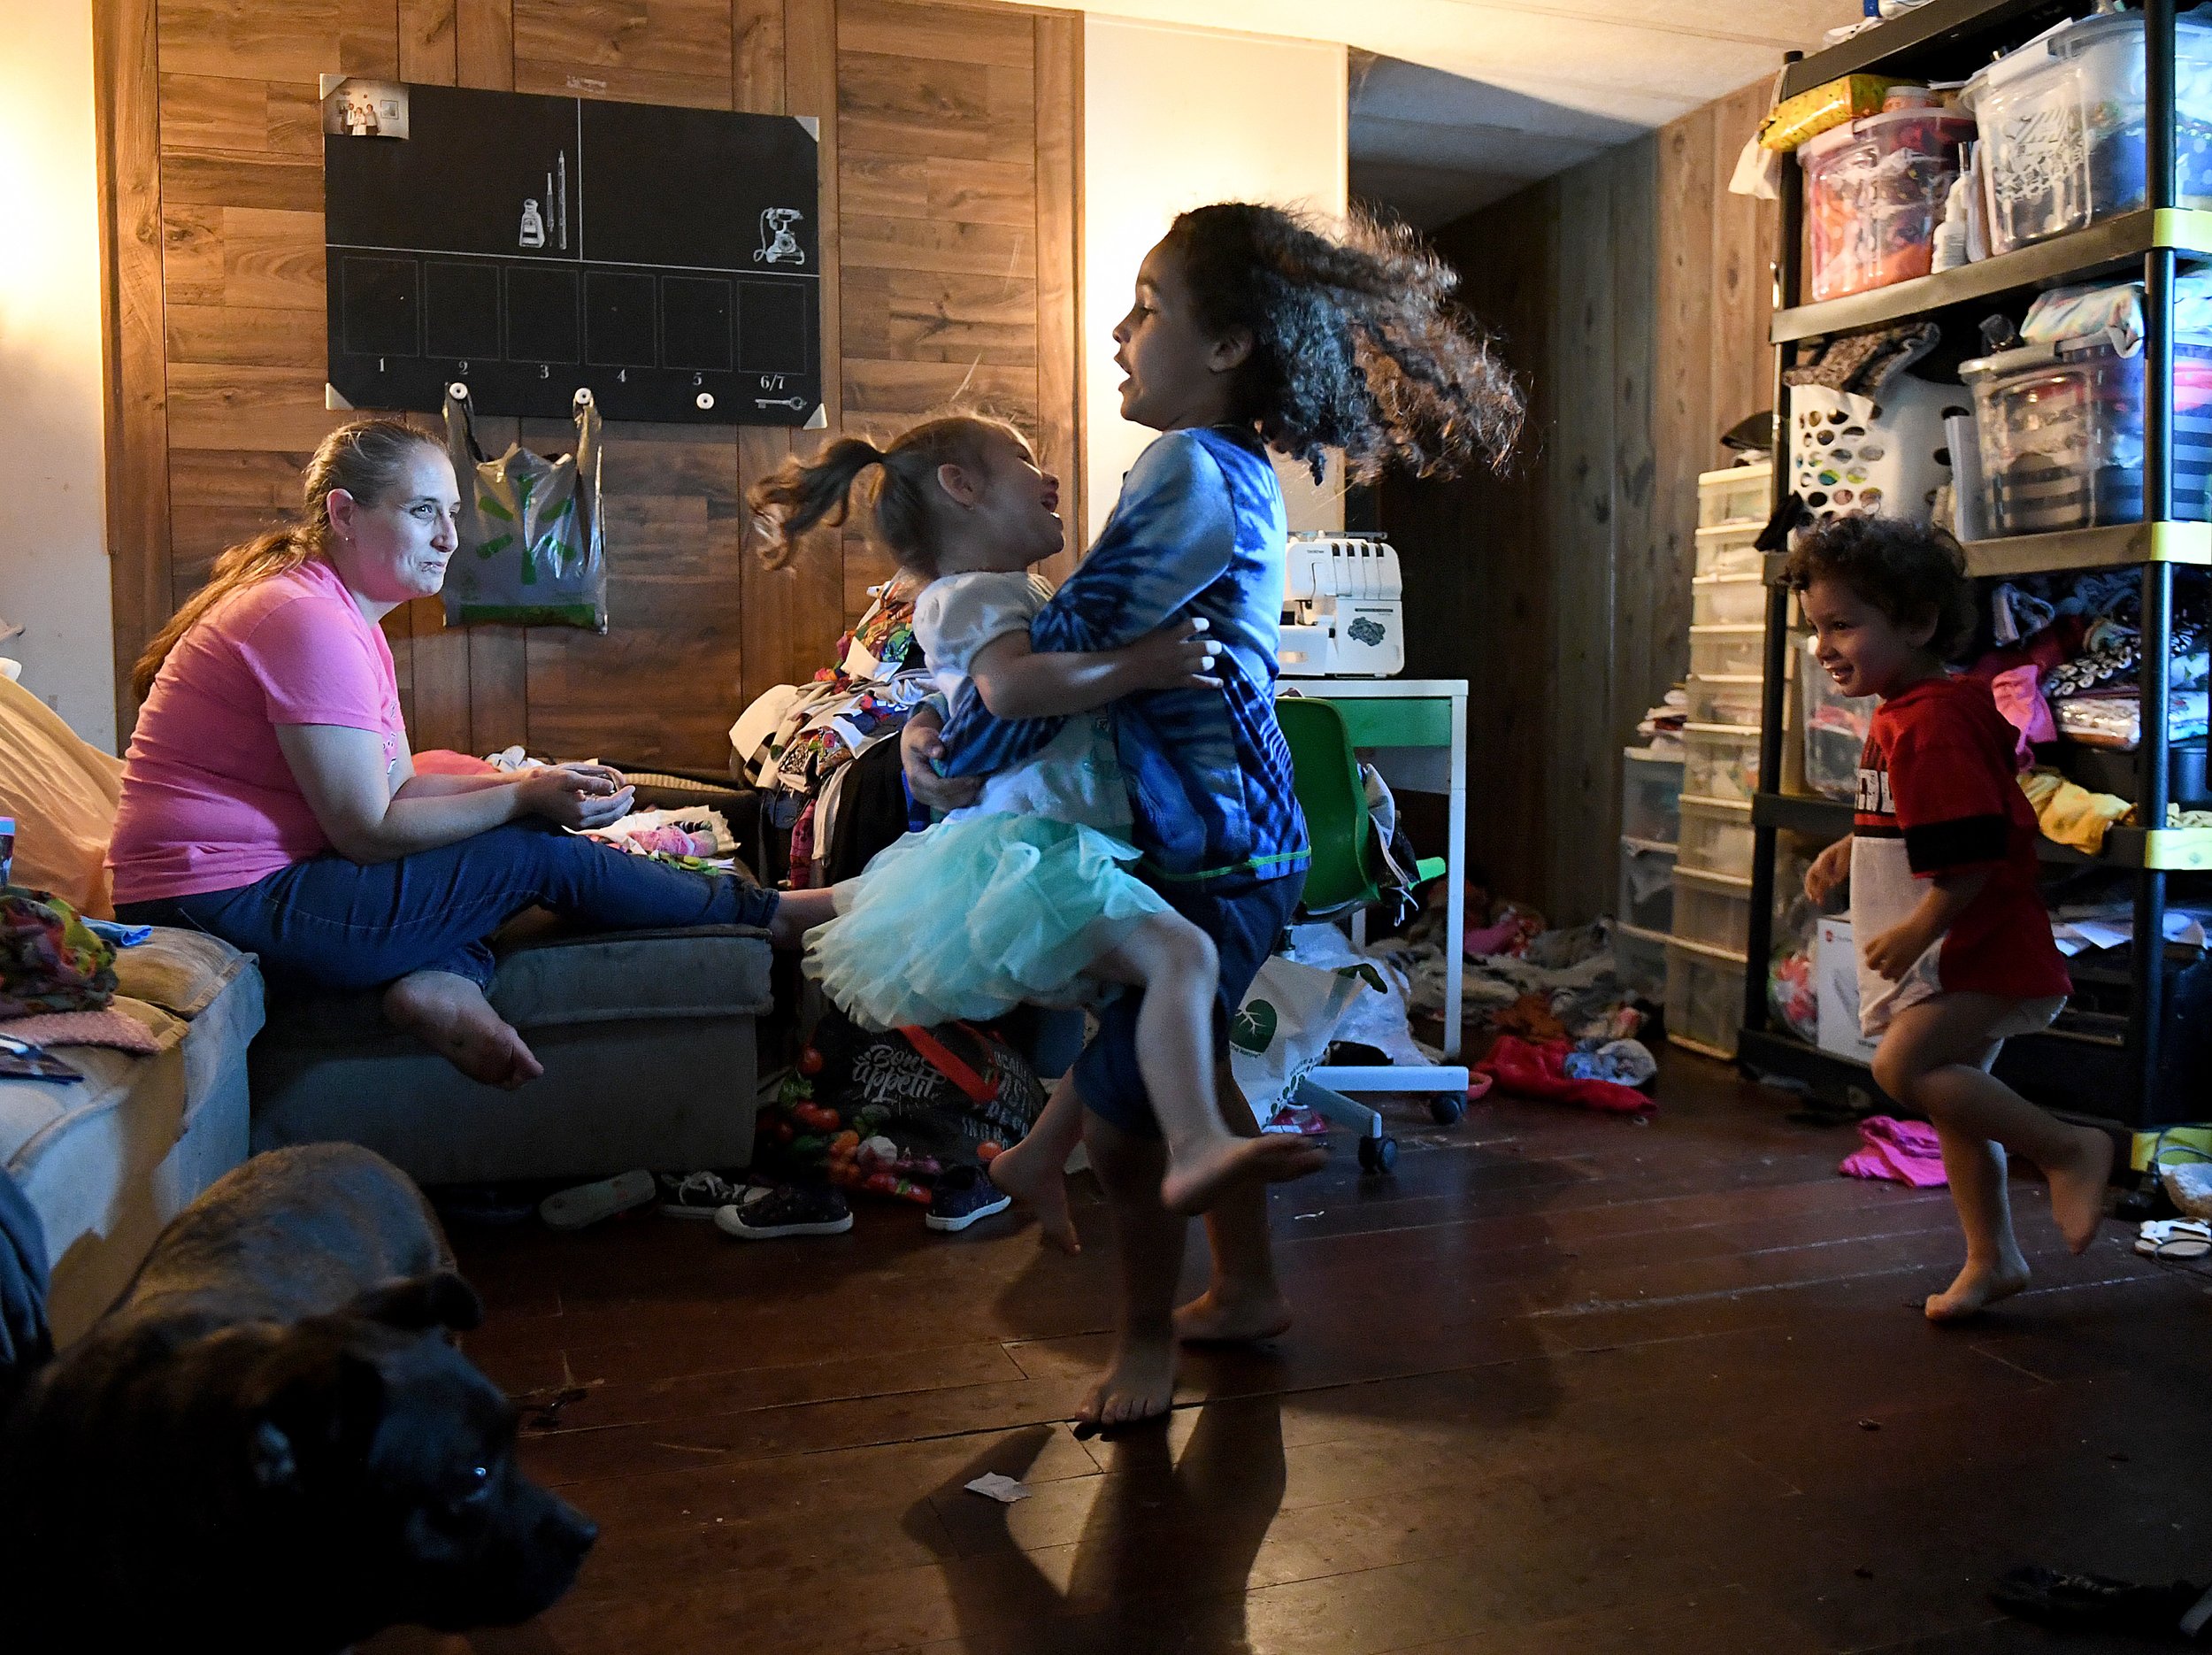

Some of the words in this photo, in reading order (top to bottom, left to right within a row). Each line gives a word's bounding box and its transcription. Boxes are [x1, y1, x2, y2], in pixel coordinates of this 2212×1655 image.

[379, 357, 385, 373] 1
[458, 360, 469, 375] 2
[539, 364, 549, 379] 3
[617, 368, 626, 382] 4
[693, 372, 703, 386] 5
[760, 373, 786, 391] 6/7
